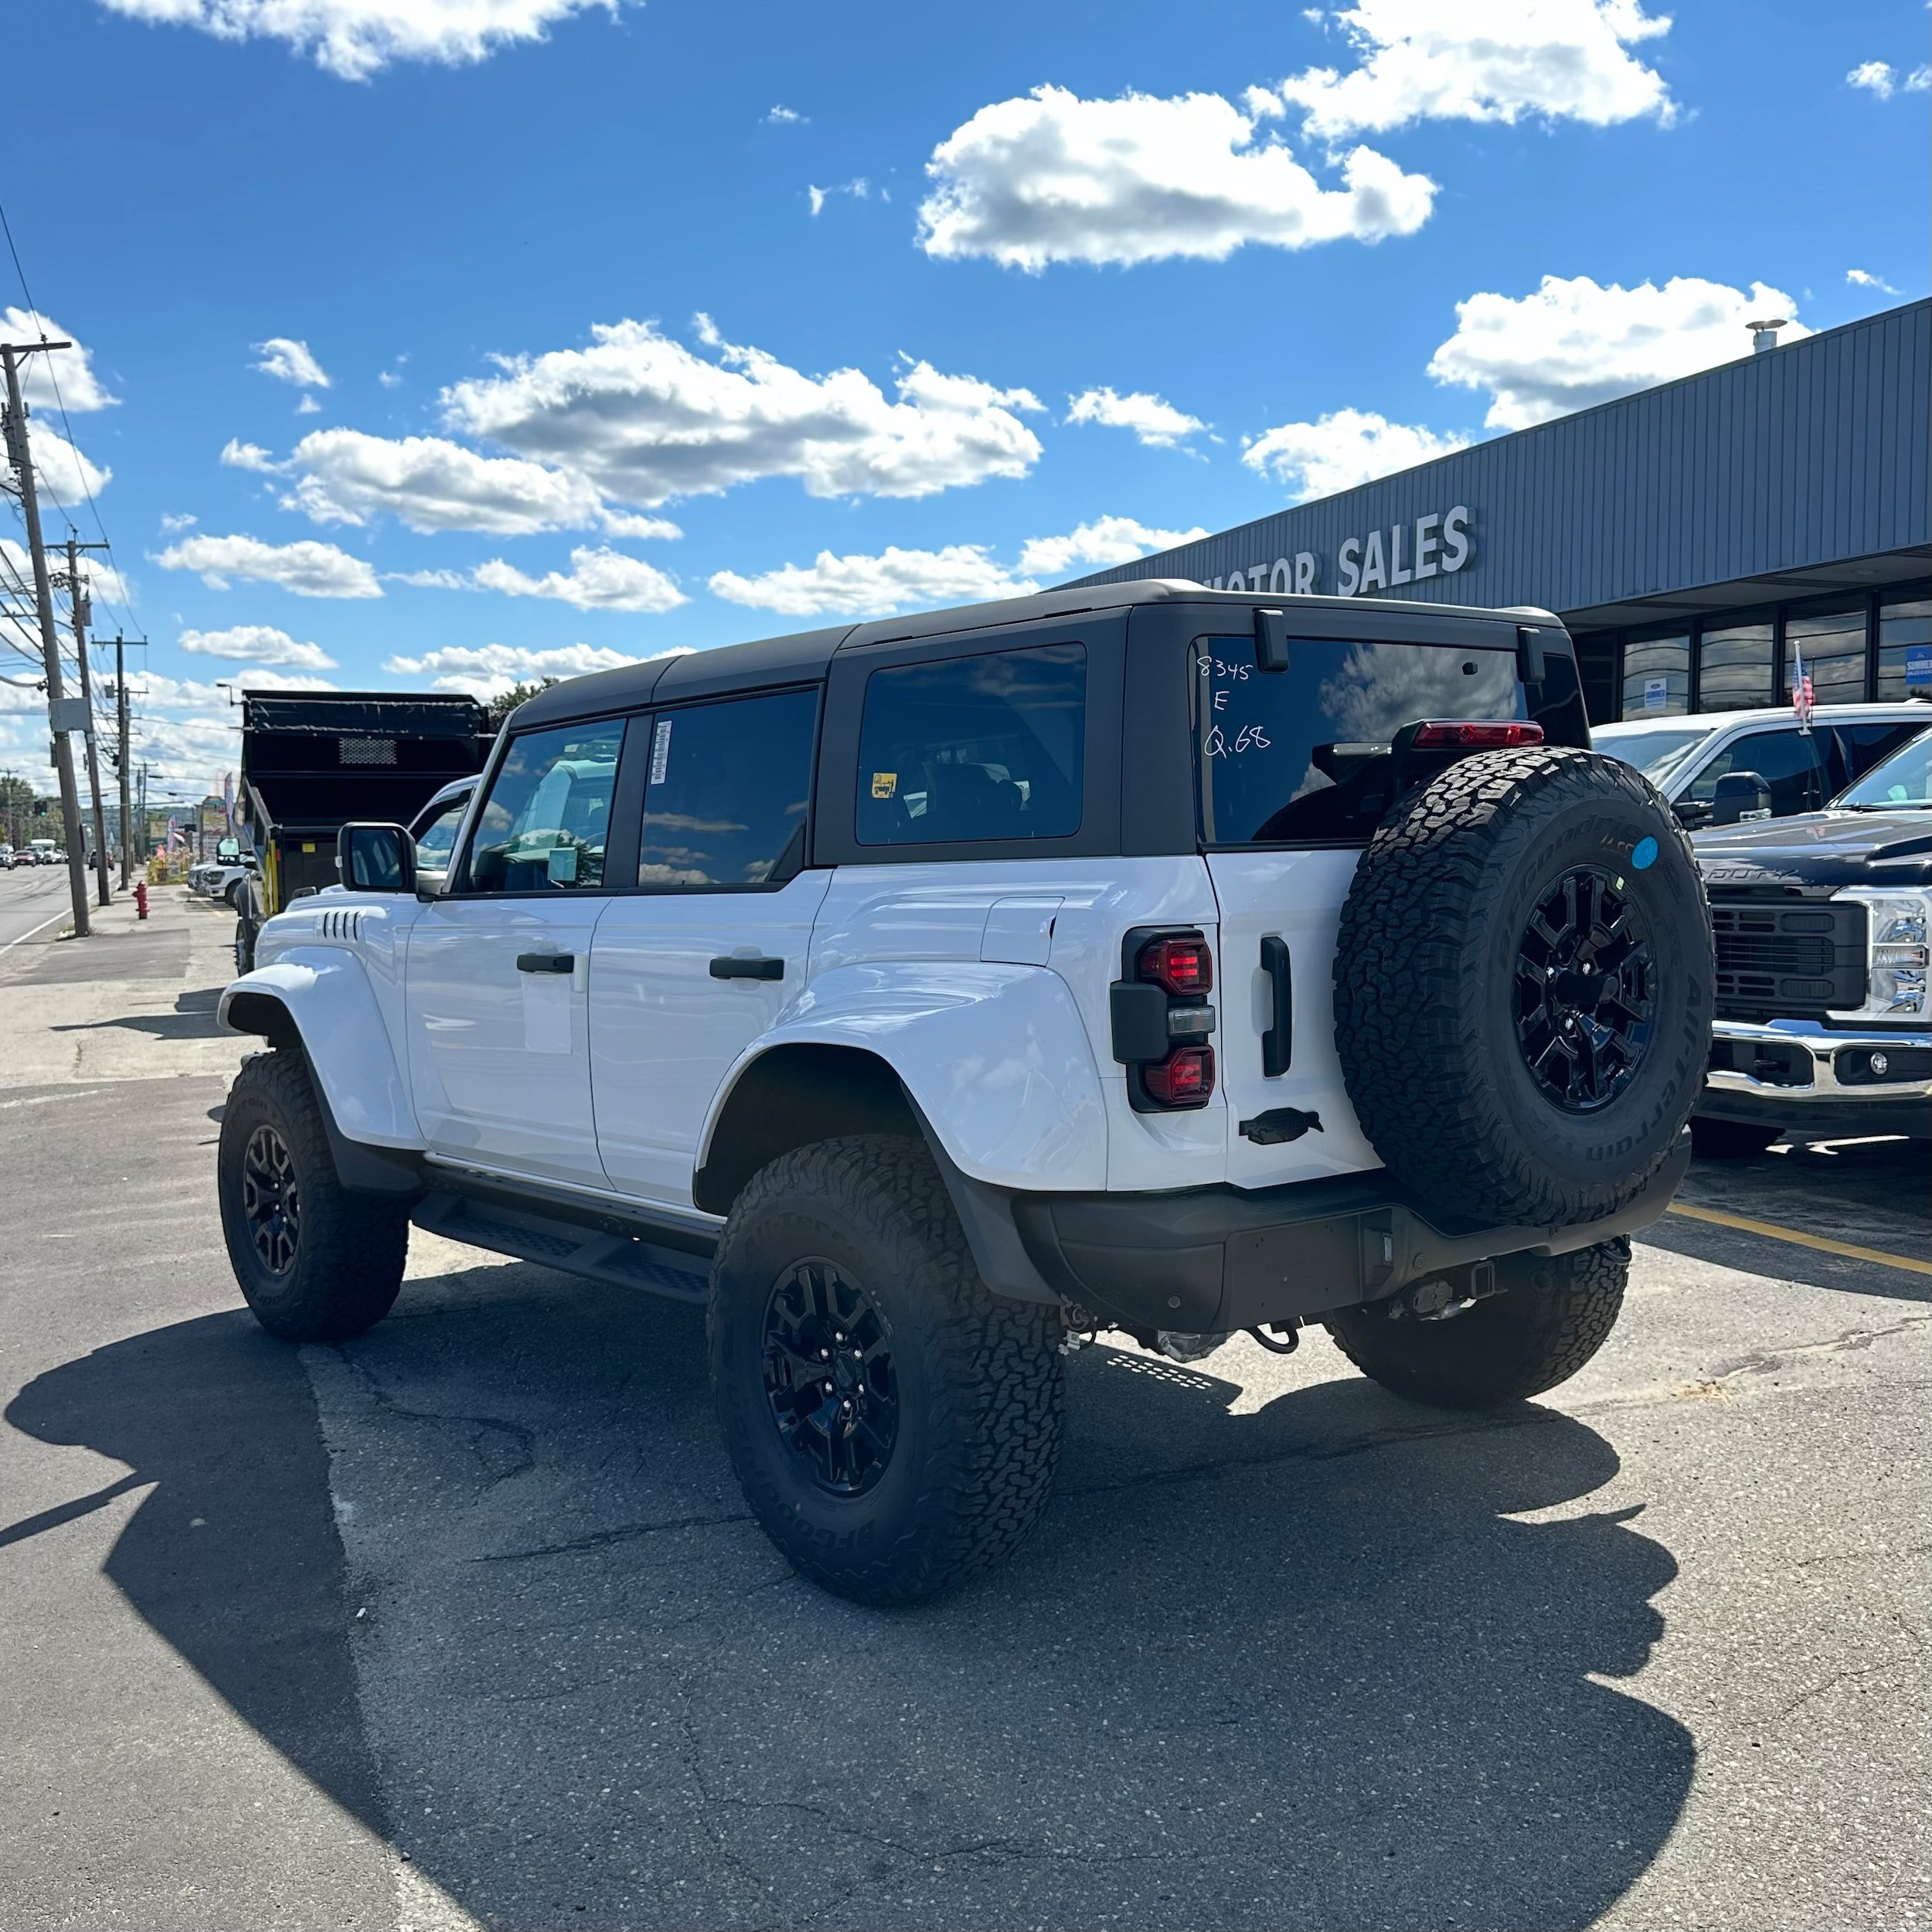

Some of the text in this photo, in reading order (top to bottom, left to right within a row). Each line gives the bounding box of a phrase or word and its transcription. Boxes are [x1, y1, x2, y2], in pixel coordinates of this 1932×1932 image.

[1203, 505, 1470, 597] TOR SALES
[1197, 655, 1253, 681] 8345
[1214, 691, 1230, 710] E
[1707, 869, 1799, 881] DUTY
[1498, 812, 1646, 971] BFGoodric
